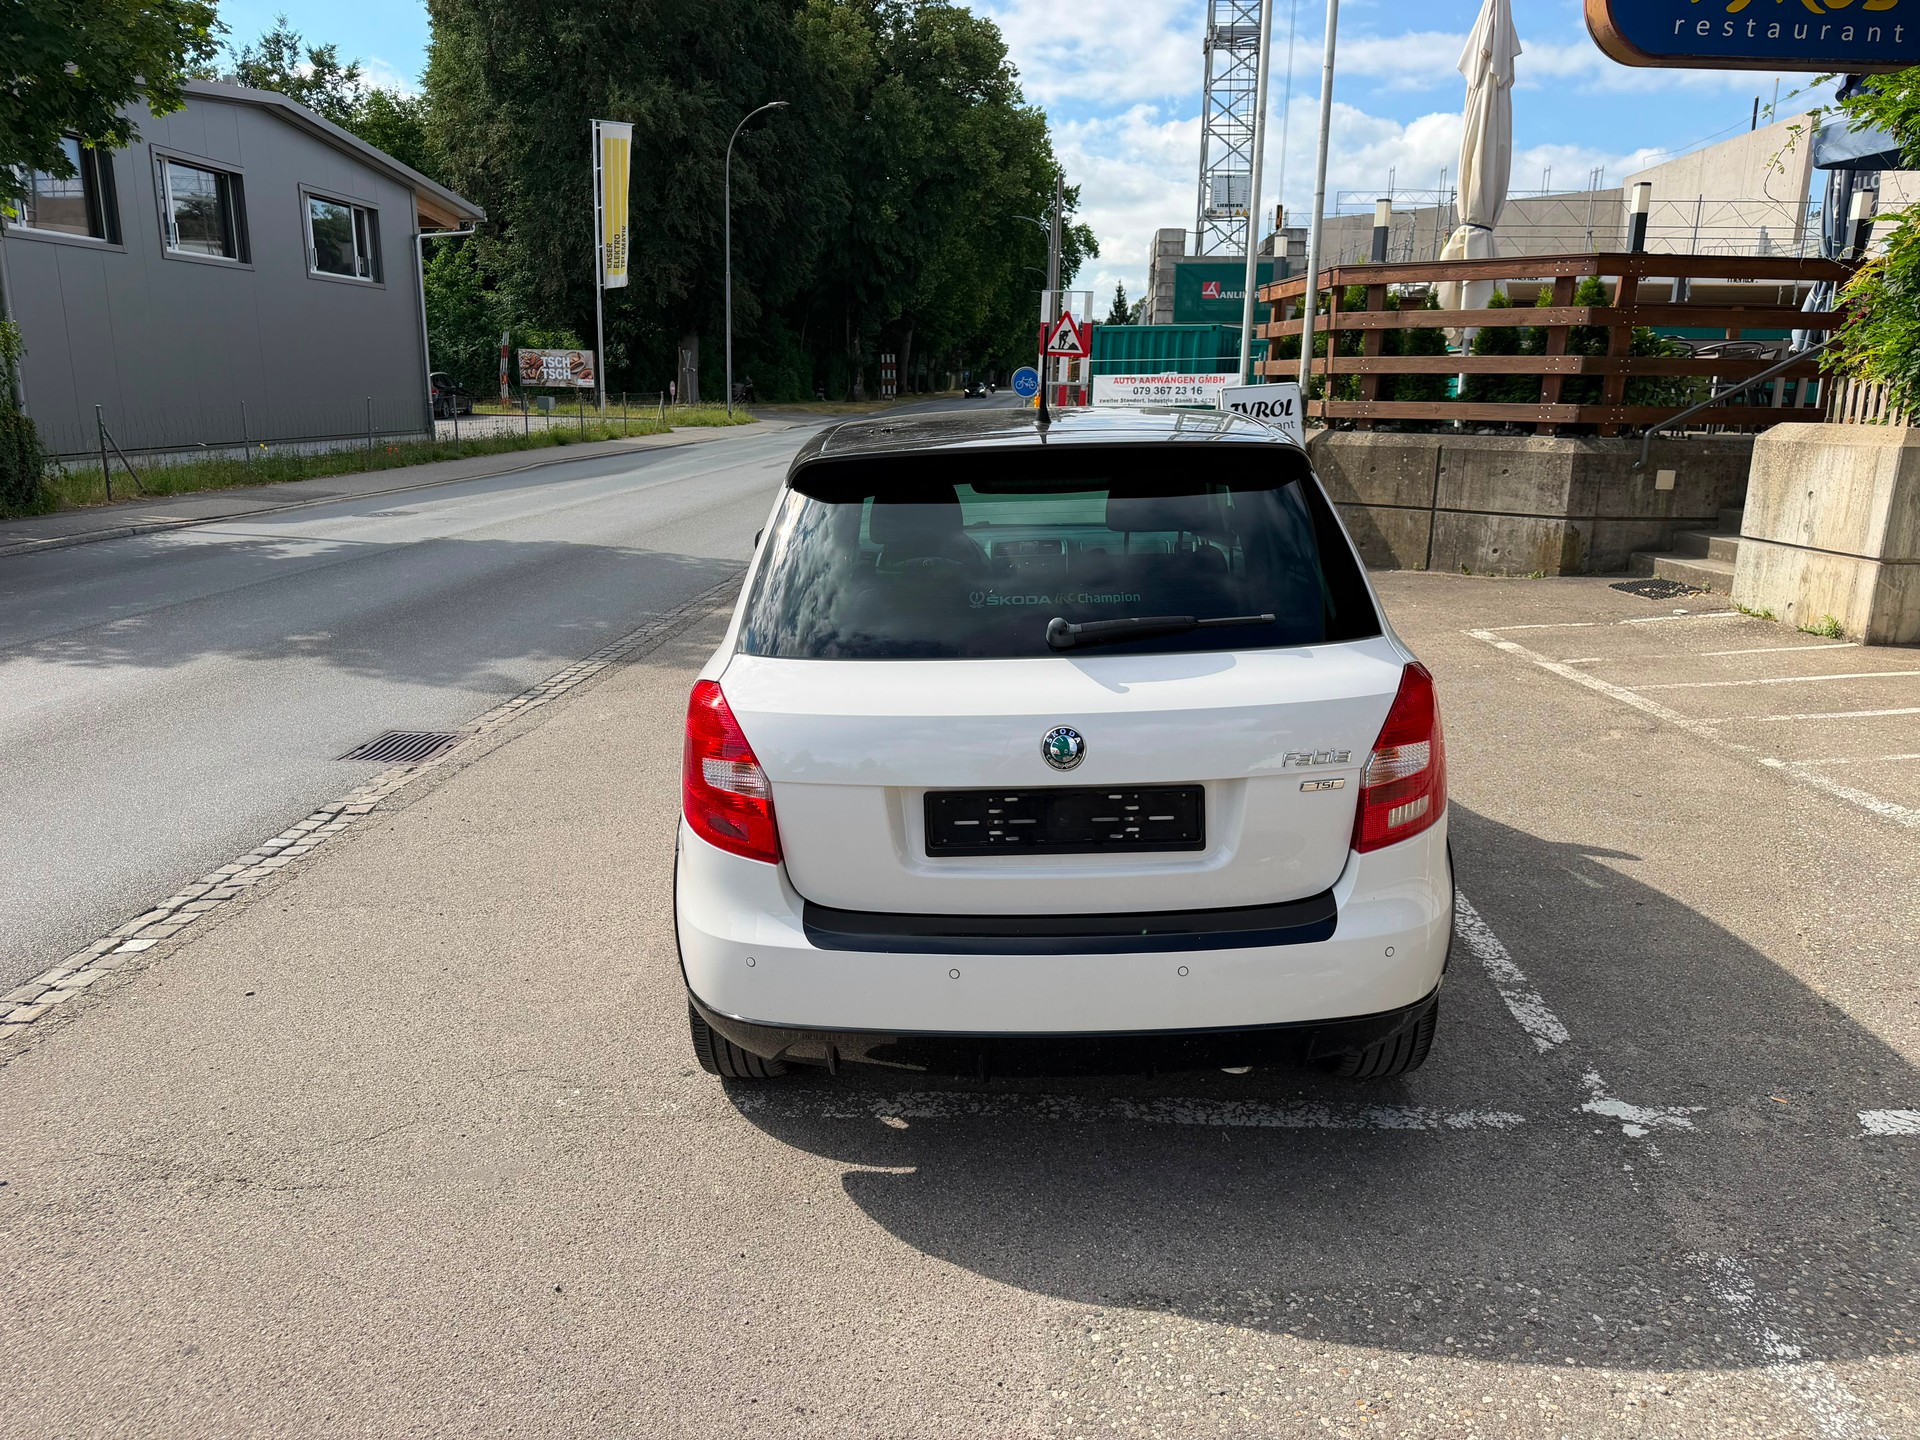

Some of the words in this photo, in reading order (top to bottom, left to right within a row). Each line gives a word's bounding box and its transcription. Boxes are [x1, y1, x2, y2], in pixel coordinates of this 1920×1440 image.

[1674, 18, 1904, 43] restaurant
[613, 233, 621, 269] ELEKTRO
[1220, 291, 1261, 299] ANLIR
[541, 356, 570, 368] TSCH
[542, 368, 571, 380] TSCH
[1113, 376, 1137, 385] AUTO
[1139, 376, 1195, 384] AARWANGEN
[1198, 376, 1226, 384] GMBH
[1132, 386, 1151, 395] 079
[1153, 386, 1172, 395] 367
[1175, 386, 1187, 395] 23
[1191, 386, 1203, 395] 16
[1077, 592, 1141, 604] Champion
[1281, 748, 1352, 768] Fabia
[1314, 781, 1335, 790] TSI
